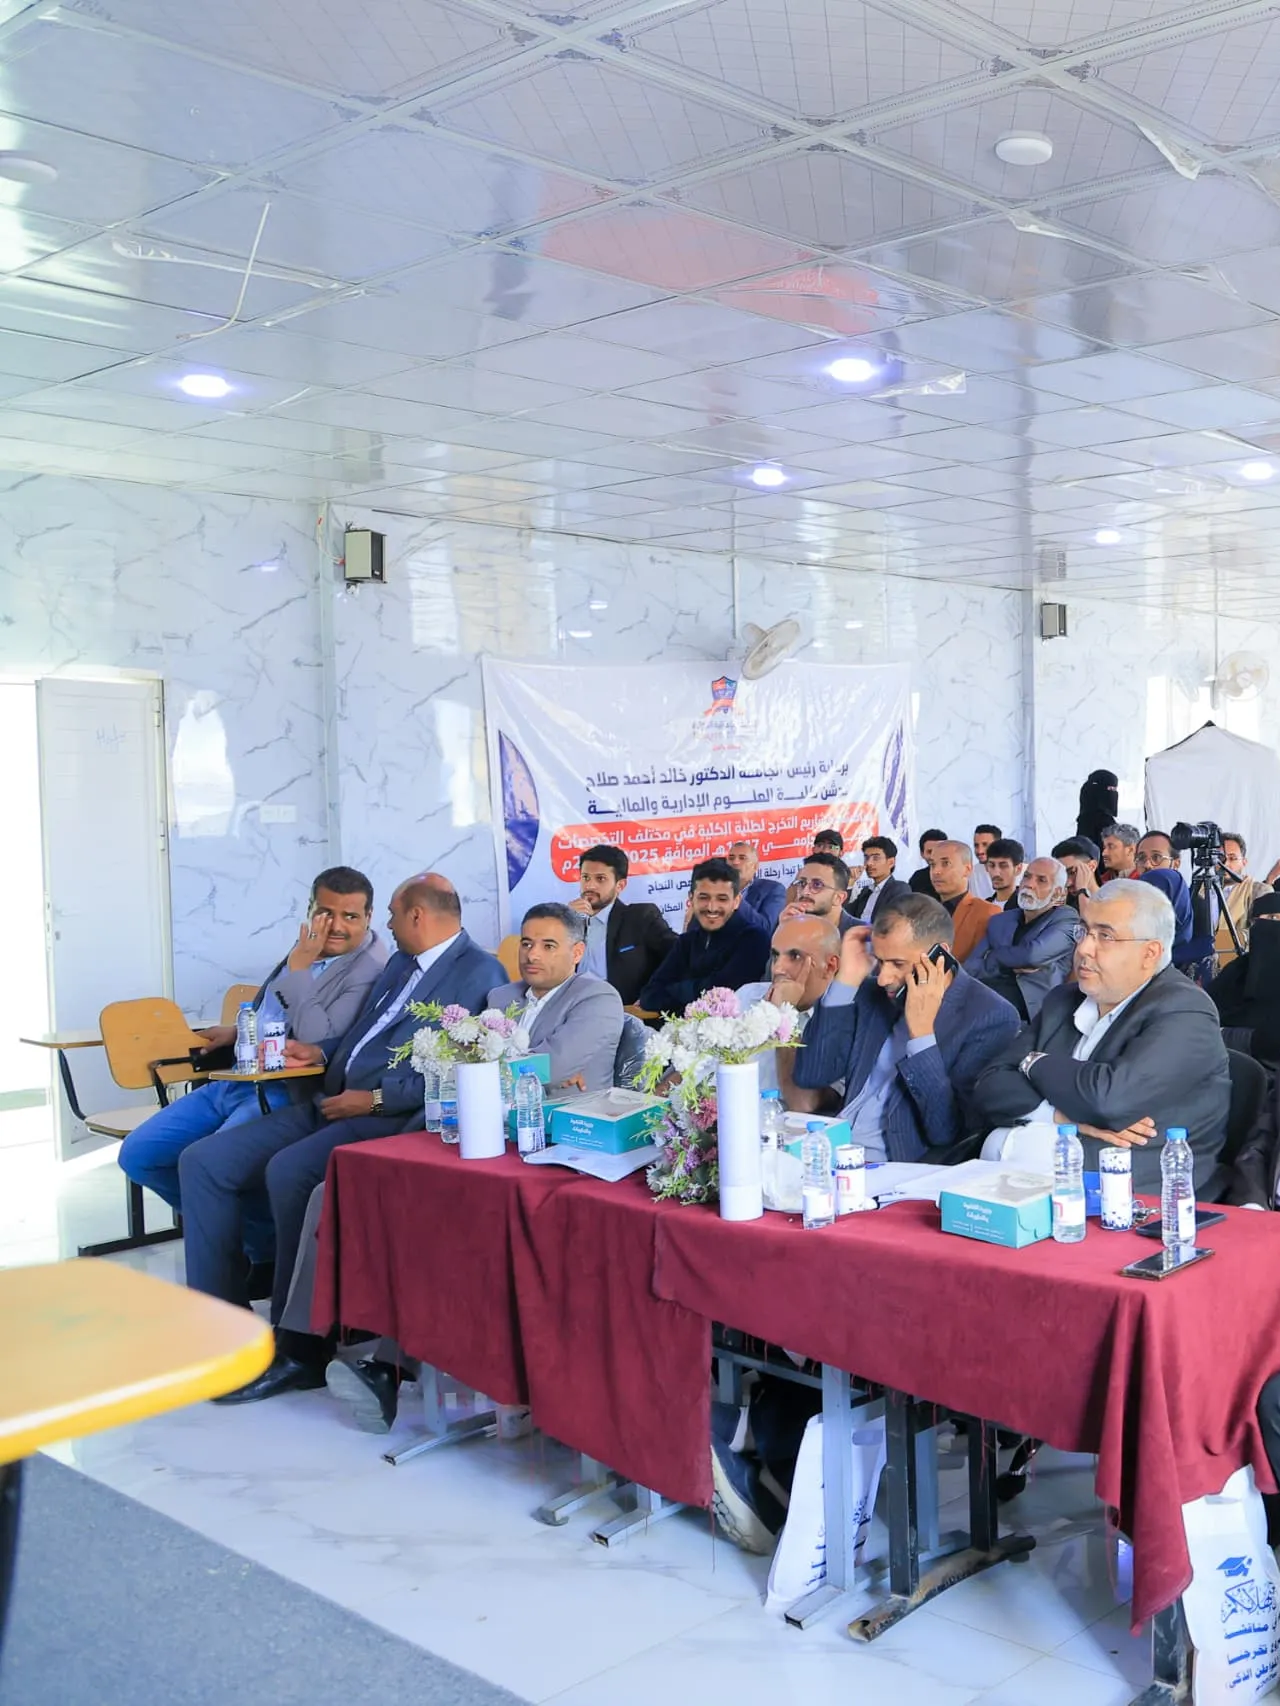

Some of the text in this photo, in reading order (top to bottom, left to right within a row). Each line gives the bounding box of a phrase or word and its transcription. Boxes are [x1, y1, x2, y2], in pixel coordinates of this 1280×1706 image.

[623, 766, 655, 785] أحمد
[660, 767, 687, 784] خالد
[690, 765, 735, 786] الدكتور
[787, 761, 816, 778] رئيس
[585, 772, 619, 792] صلاح
[662, 792, 710, 813] الإدارية
[698, 818, 732, 838] الكلية
[735, 817, 765, 836] لطلبة
[768, 815, 798, 834] التخرج
[628, 827, 671, 844] مختلف
[674, 825, 695, 844] في
[627, 848, 658, 864] 025
[661, 843, 710, 864] الموافق
[764, 867, 781, 879] رحلة
[783, 864, 796, 878] تبدأ
[648, 879, 673, 895] النجاح
